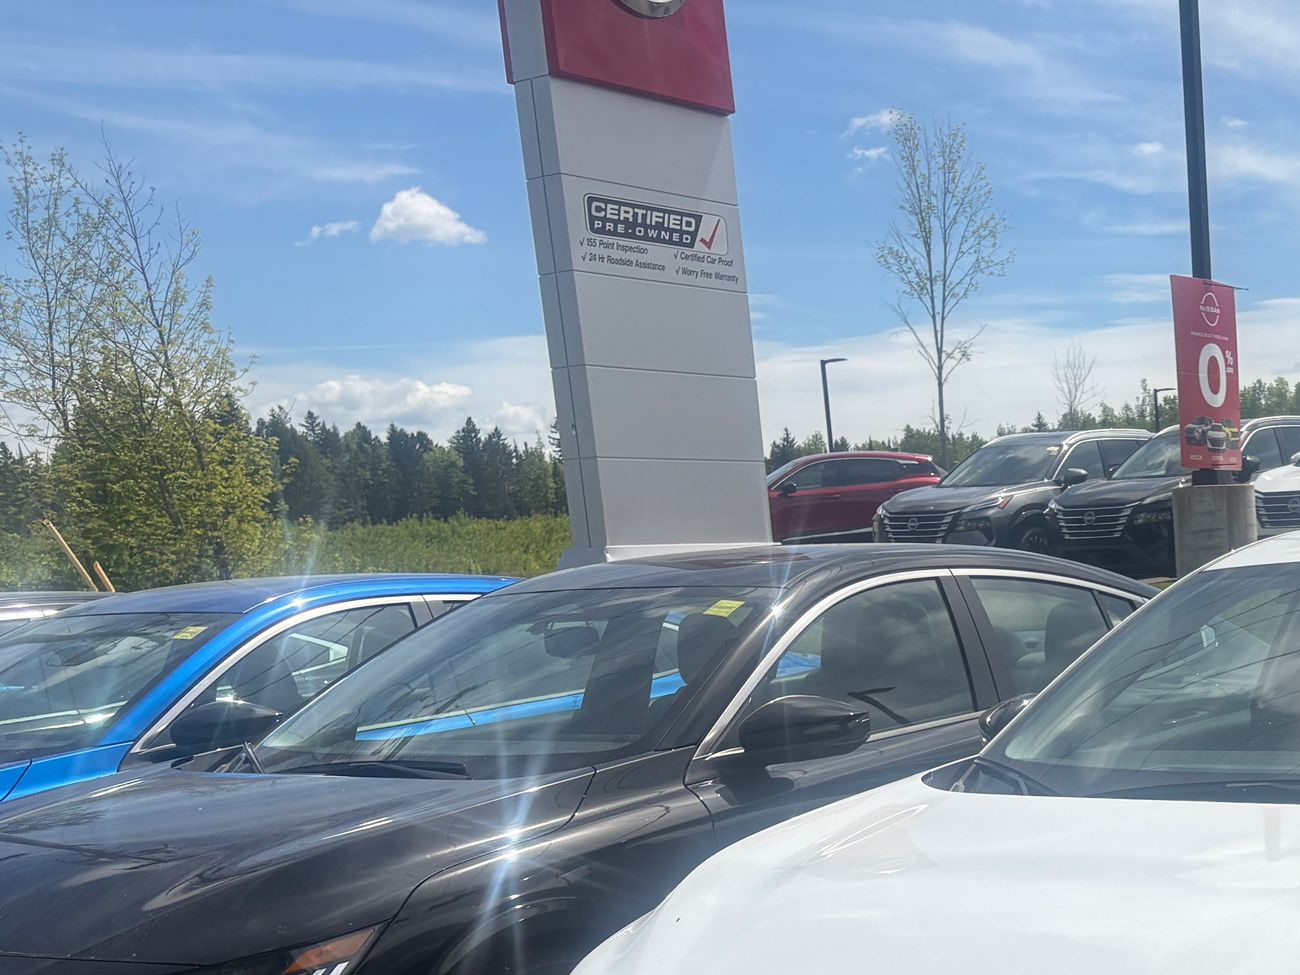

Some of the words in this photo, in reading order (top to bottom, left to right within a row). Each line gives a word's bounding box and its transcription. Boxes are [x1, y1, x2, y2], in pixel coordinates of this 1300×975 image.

[591, 201, 696, 232] CERTIFIED
[594, 220, 692, 244] PRE-OWNED
[586, 238, 597, 248] 155
[598, 239, 615, 250] Point
[616, 242, 649, 255] Inspection
[589, 252, 597, 262] 24
[598, 253, 606, 263] Hr
[607, 255, 634, 268] Roadside
[634, 259, 666, 272] Assistance
[680, 251, 706, 264] Certified
[706, 255, 717, 265] Car
[718, 257, 734, 267] Proof
[681, 266, 700, 279] Worry
[700, 269, 713, 279] Free
[714, 271, 739, 285] Warranty
